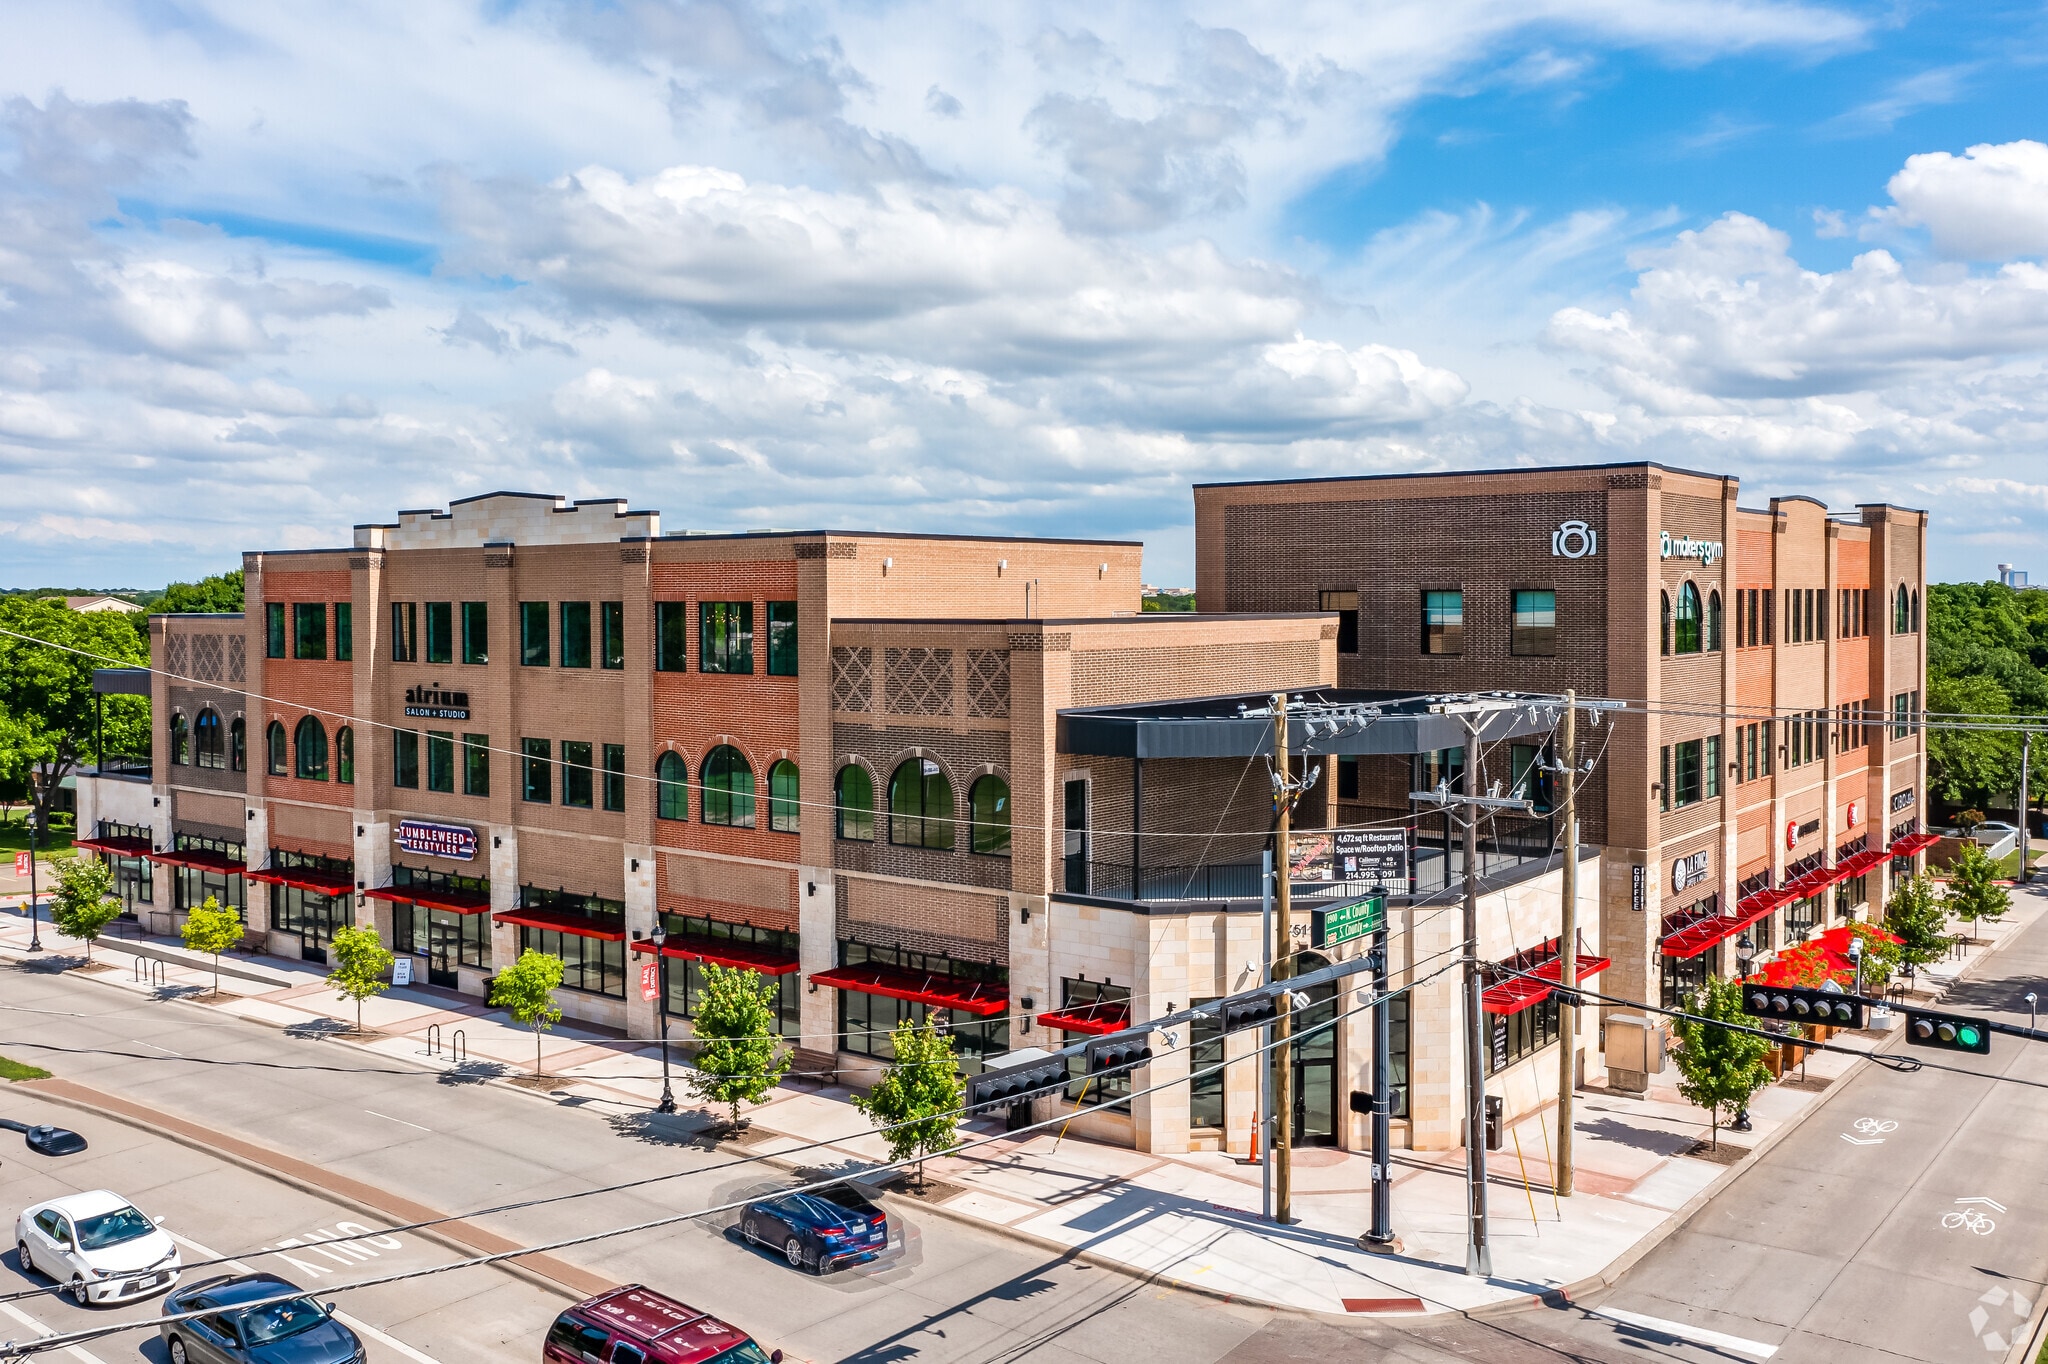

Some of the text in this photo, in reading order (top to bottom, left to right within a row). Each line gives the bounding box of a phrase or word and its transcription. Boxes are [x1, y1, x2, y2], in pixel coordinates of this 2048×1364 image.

[405, 682, 468, 707] atrium
[406, 707, 430, 717] SALON
[439, 709, 466, 719] STUDIO
[400, 826, 464, 845] TUMBLEWEED
[1337, 833, 1402, 844] 4,672 sq ft Restaurant
[408, 839, 457, 854] TEXSTYLES
[1336, 843, 1404, 855] Space w/Rooftop Patio
[1686, 855, 1694, 874] LA
[1345, 870, 1396, 880] 214.995.091
[1352, 902, 1370, 918] County
[1345, 921, 1363, 937] County
[642, 967, 650, 985] RAIL
[262, 1221, 403, 1278] ONLY
